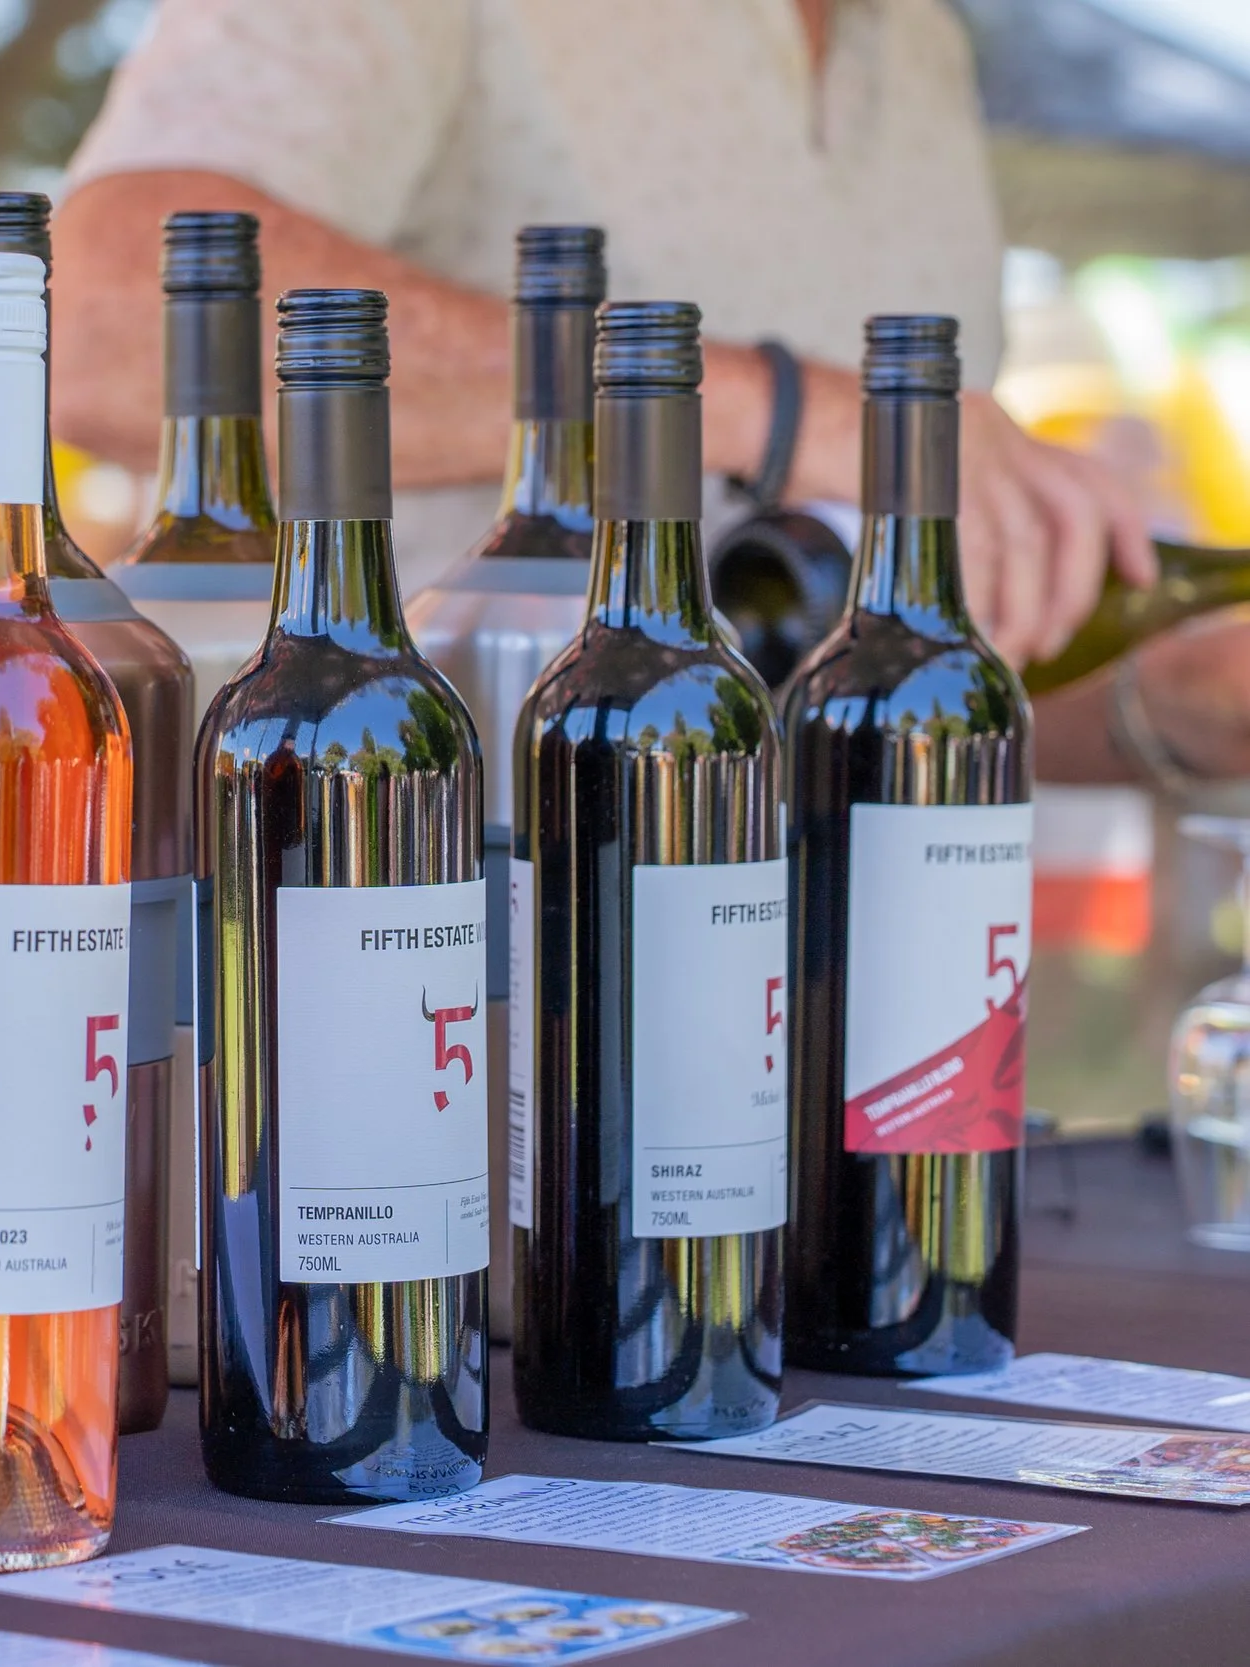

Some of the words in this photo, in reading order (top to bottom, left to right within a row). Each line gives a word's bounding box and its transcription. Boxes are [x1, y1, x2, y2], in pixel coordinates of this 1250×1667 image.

[925, 844, 976, 864] FIFTH
[711, 903, 757, 925] FIFTH
[13, 930, 72, 952] FIFTH
[77, 928, 124, 951] ESTATE
[361, 928, 419, 950] FIFTH
[423, 924, 474, 948] ESTATE
[985, 923, 1020, 1013] 5
[433, 1006, 473, 1112] 5
[83, 1014, 119, 1127] 5
[651, 1164, 702, 1178] SHIRAZ
[651, 1189, 703, 1202] WESTERN
[705, 1186, 755, 1200] AUSTRALIA
[298, 1205, 393, 1220] TEMPRANILLO
[651, 1211, 692, 1226] 750ML
[298, 1233, 354, 1246] WESTERN
[358, 1231, 420, 1245] AUSTRALIA
[5, 1257, 67, 1271] AUSTRALIA
[298, 1256, 342, 1271] 750ML
[398, 1480, 579, 1526] TEMPRANILLO
